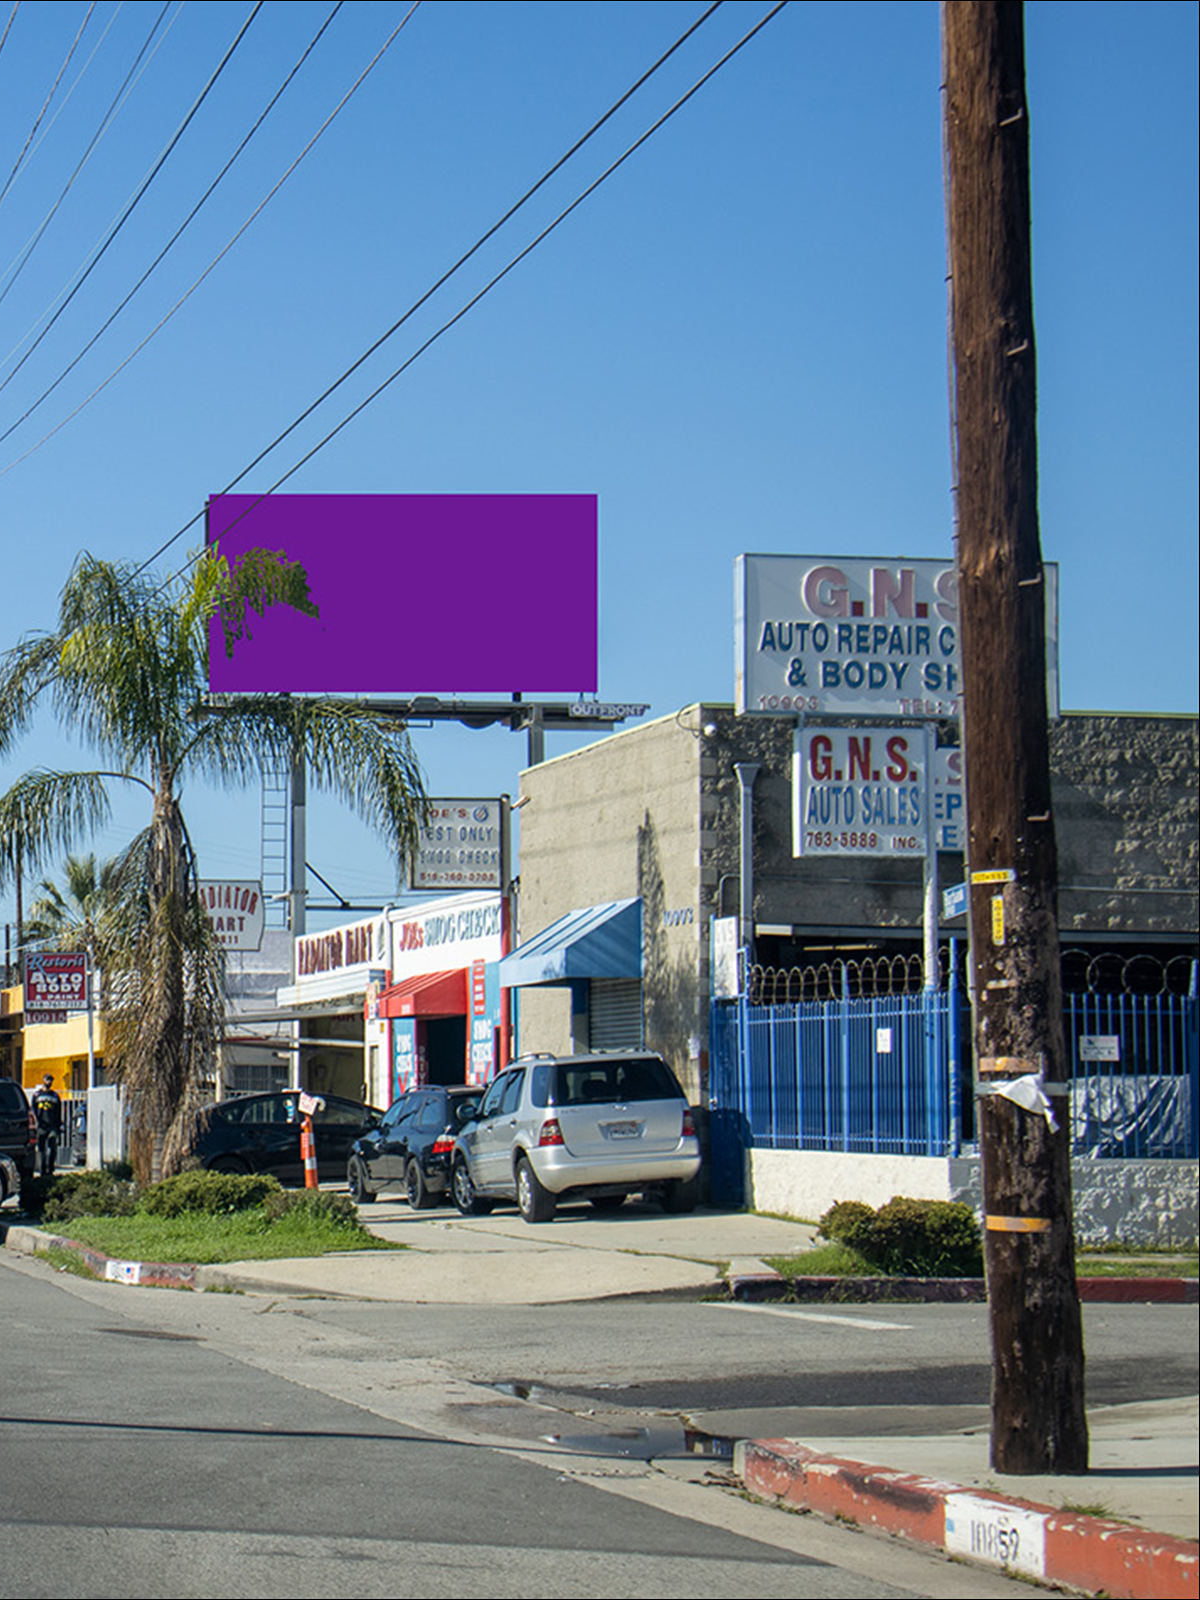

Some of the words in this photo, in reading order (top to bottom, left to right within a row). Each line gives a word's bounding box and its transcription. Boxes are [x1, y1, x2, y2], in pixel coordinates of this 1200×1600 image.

[759, 621, 829, 652] AUTO
[837, 623, 931, 656] REPAIR
[786, 658, 808, 688] &
[820, 660, 909, 690] BODY
[572, 705, 644, 717] OUTFRONT
[808, 734, 918, 783] G.N.S.
[430, 807, 467, 819] OE'S
[807, 786, 856, 825] AUTO
[860, 786, 921, 826] SALES
[420, 826, 453, 841] TEST
[460, 826, 493, 841] ONLY
[458, 850, 498, 864] CHECK
[200, 885, 259, 916] ADIATOR
[457, 904, 501, 941] CHECK
[30, 971, 83, 984] AUTO
[36, 983, 82, 993] BODY
